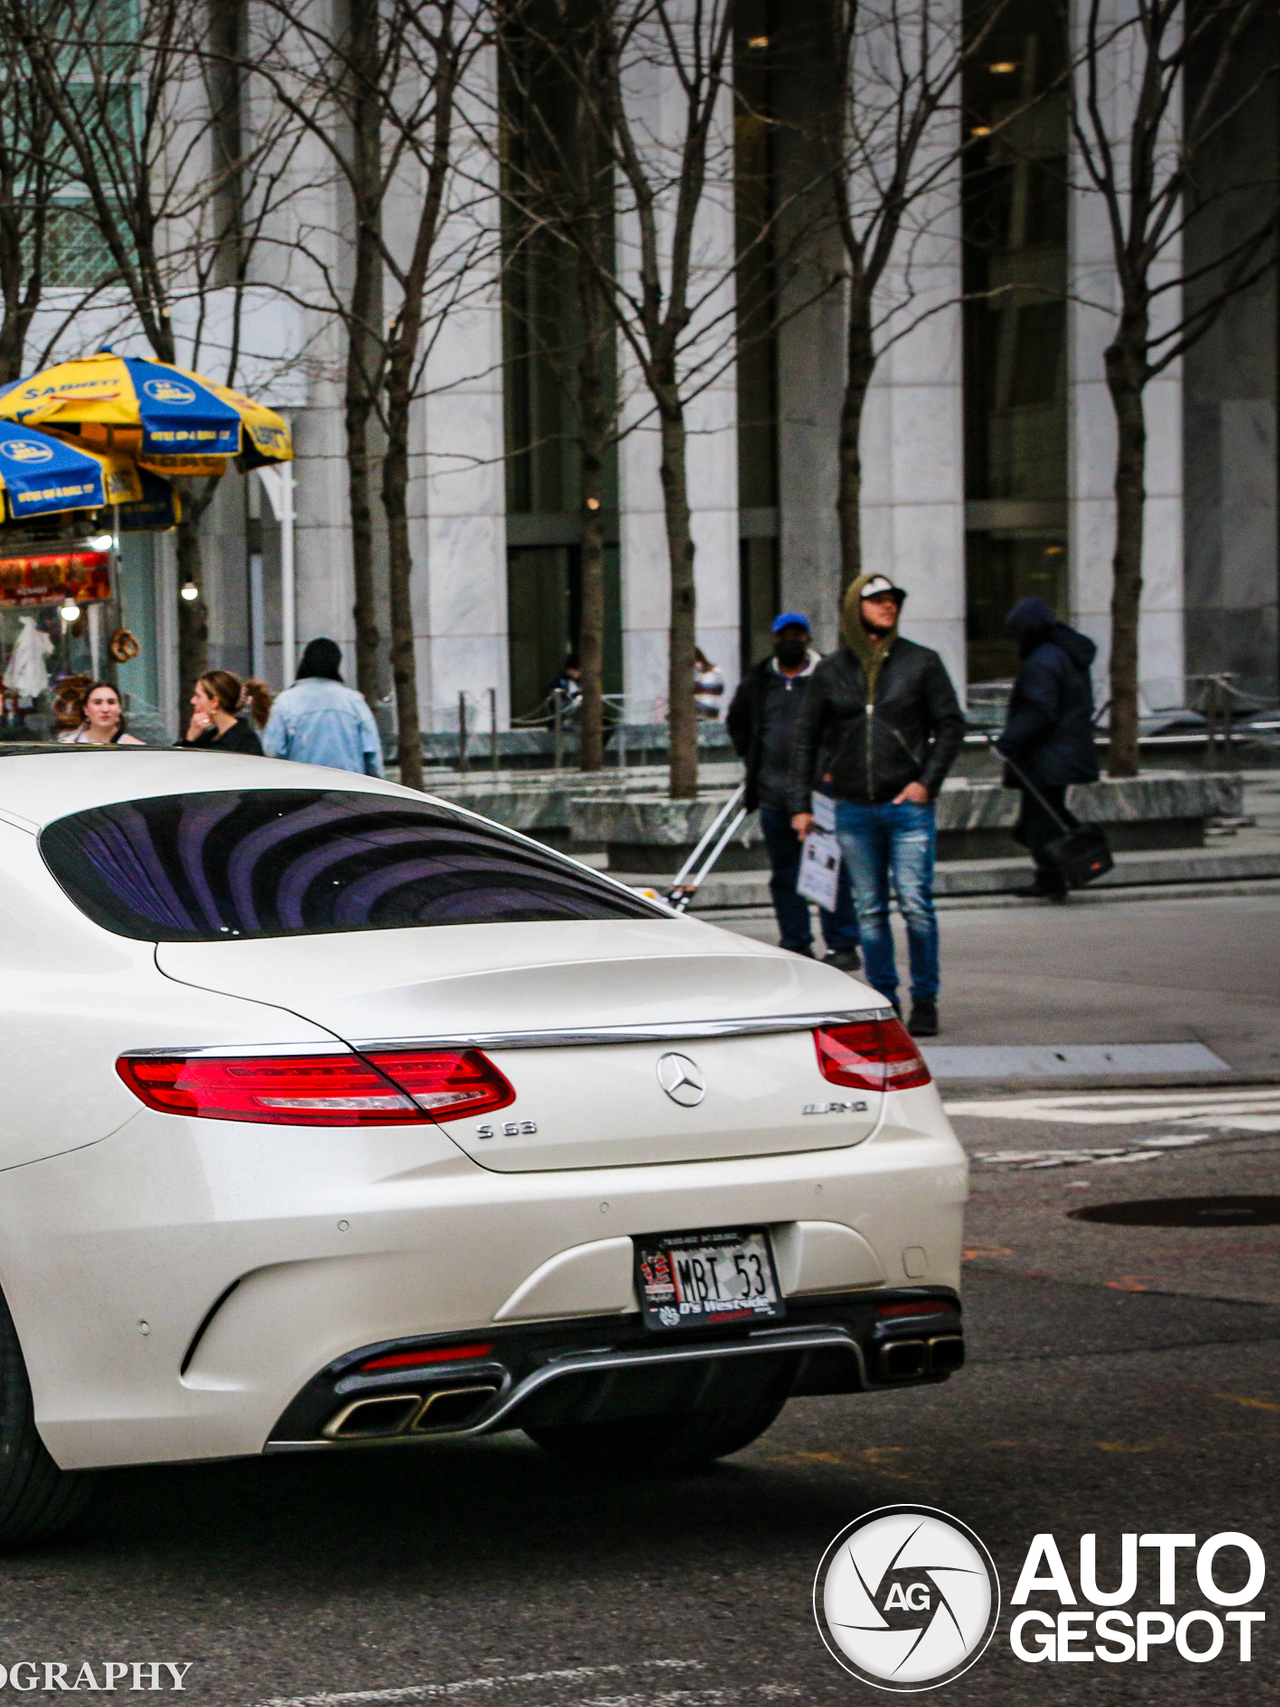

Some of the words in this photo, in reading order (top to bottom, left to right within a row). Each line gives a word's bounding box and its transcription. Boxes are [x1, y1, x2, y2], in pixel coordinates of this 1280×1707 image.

[475, 1124, 495, 1140] S
[502, 1119, 538, 1137] 63
[677, 1256, 721, 1303] MBT
[733, 1253, 766, 1298] 53
